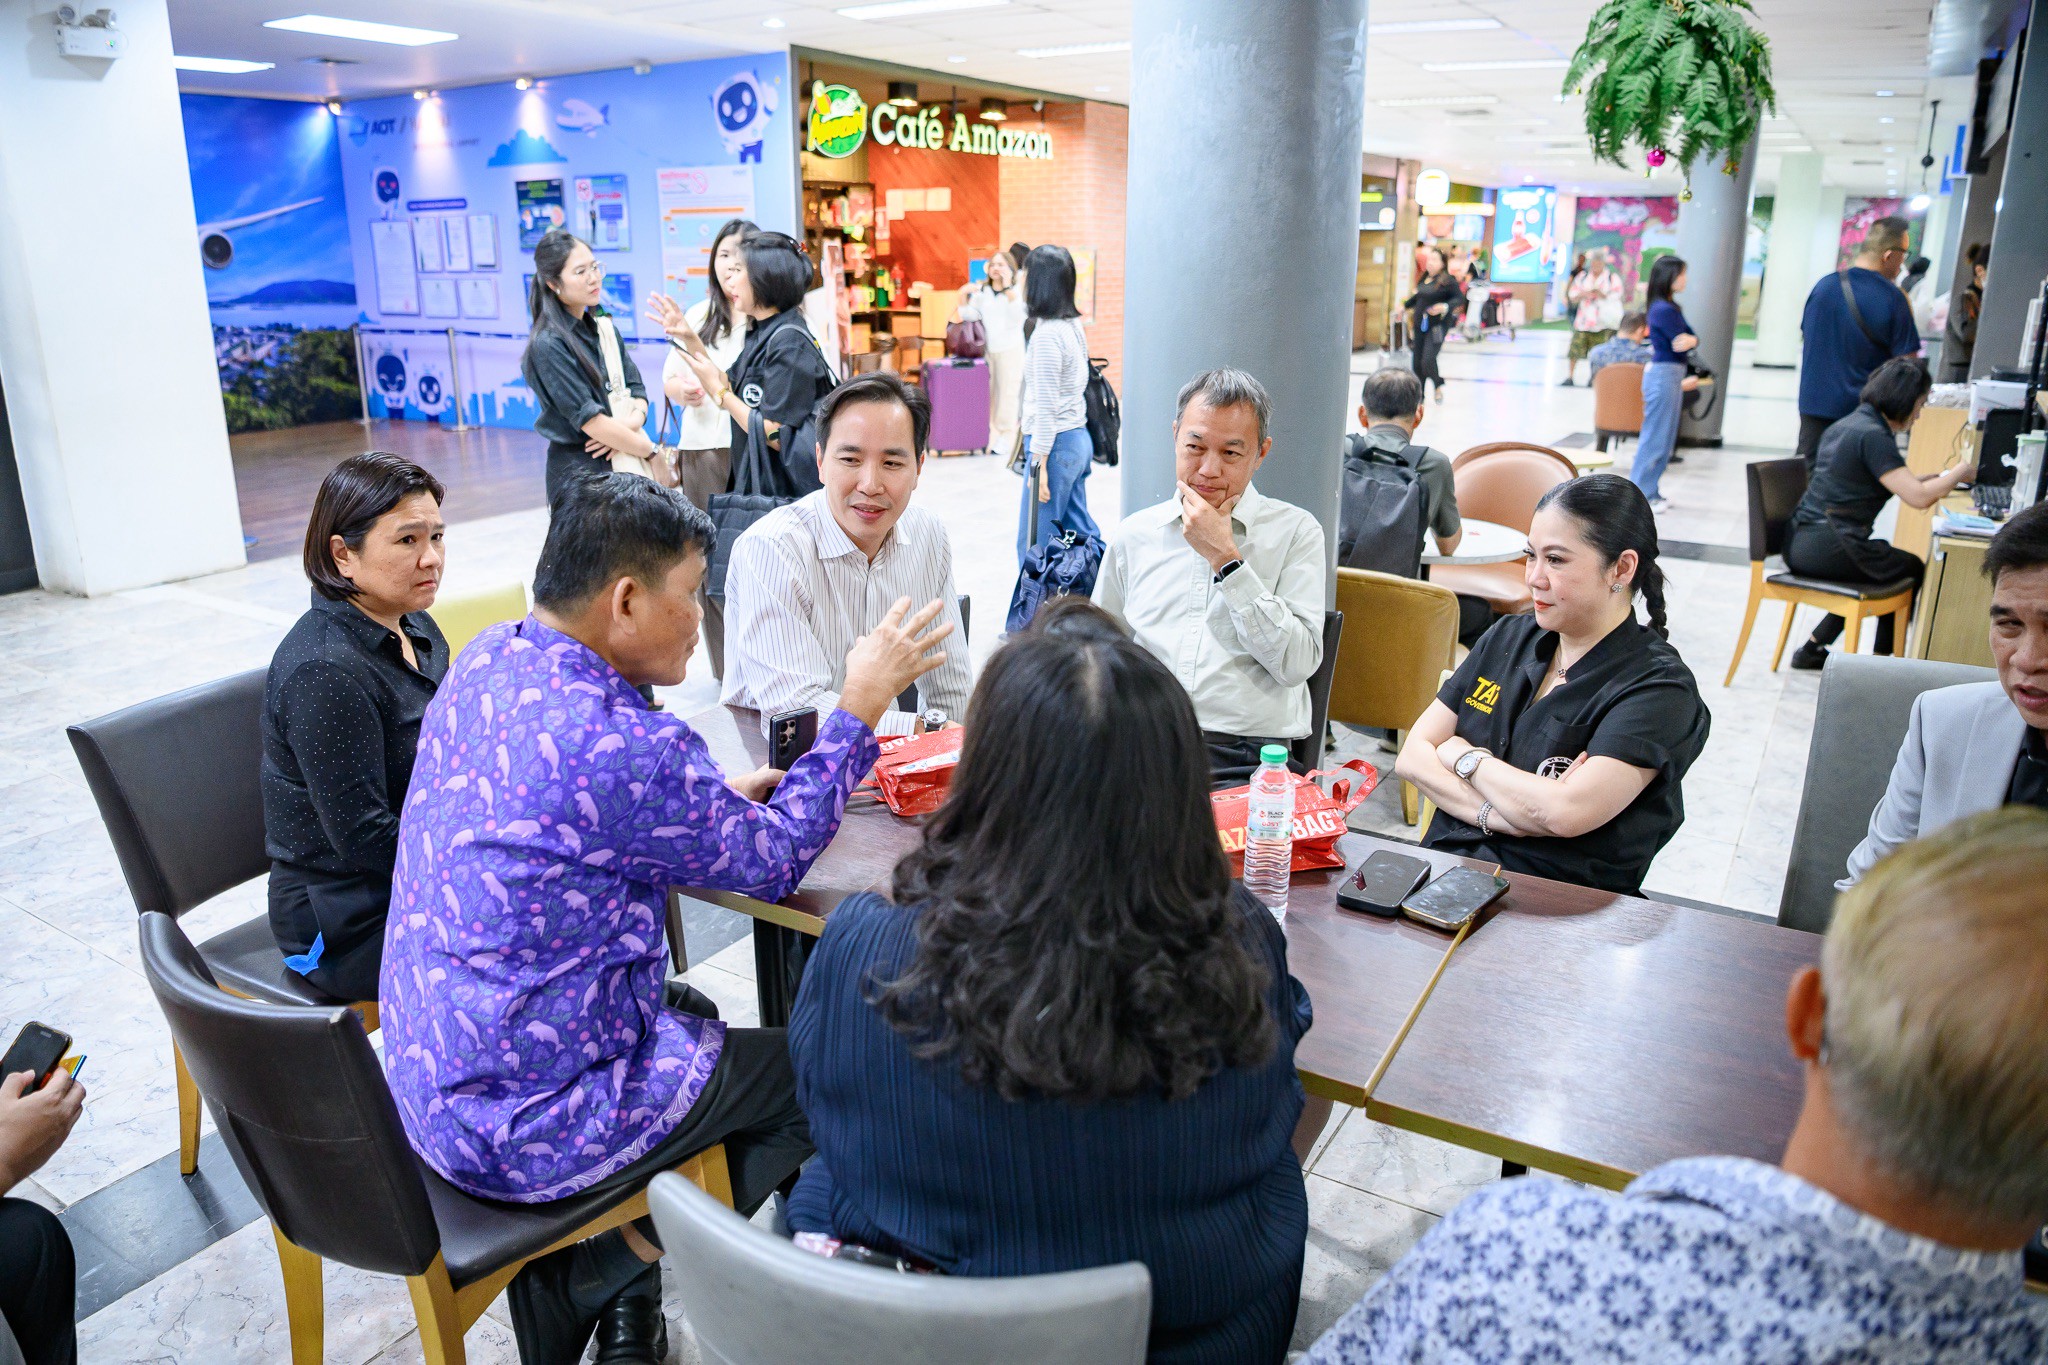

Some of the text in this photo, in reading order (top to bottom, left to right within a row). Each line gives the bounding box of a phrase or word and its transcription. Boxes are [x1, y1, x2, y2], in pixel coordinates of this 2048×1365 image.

[872, 102, 944, 151] Café
[950, 112, 1054, 160] Amazon
[1293, 811, 1337, 840] BAG
